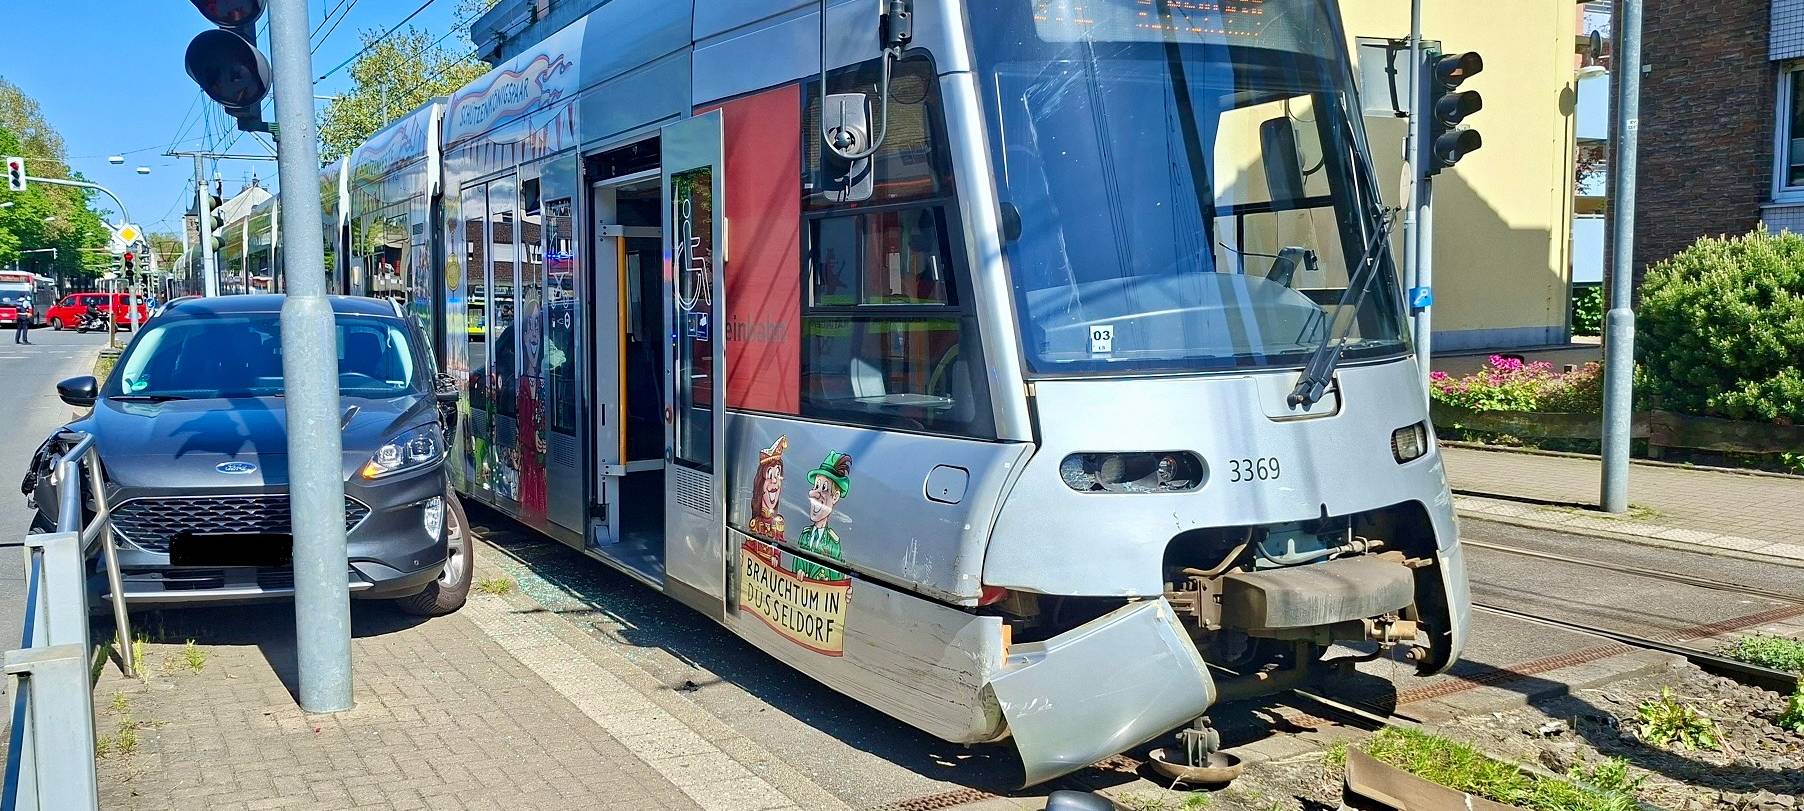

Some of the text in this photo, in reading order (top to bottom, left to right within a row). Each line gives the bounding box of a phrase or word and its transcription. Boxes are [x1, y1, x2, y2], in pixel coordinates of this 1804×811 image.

[725, 313, 786, 342] einbahn
[1093, 330, 1111, 341] 03
[1229, 457, 1280, 483] 3369
[746, 557, 840, 615] BRAUCHTUM IN
[747, 582, 835, 643] DÜSSELDORF
